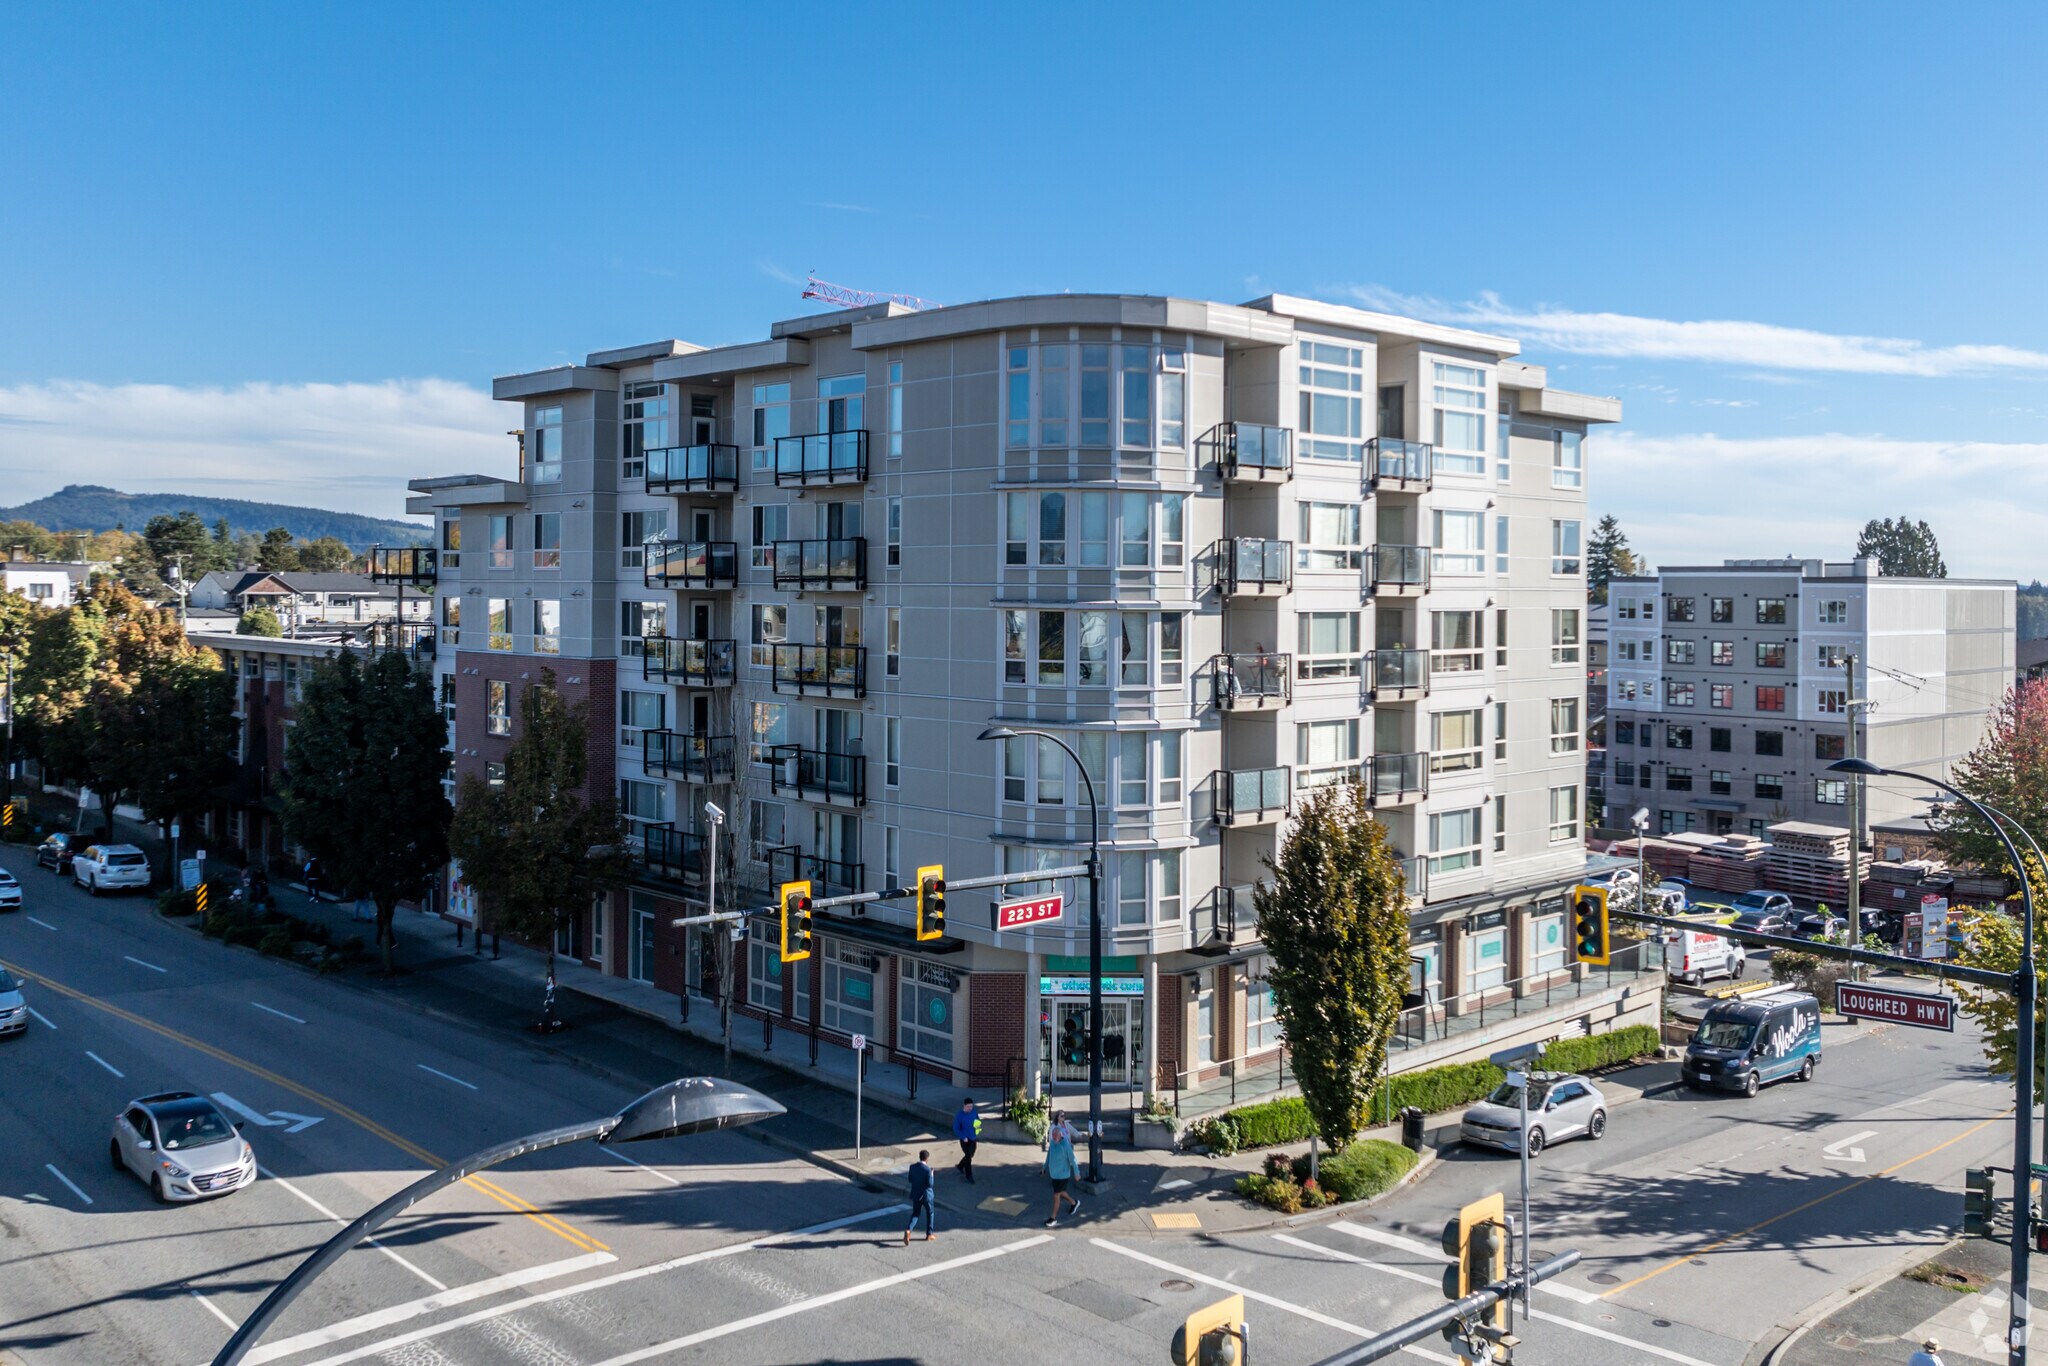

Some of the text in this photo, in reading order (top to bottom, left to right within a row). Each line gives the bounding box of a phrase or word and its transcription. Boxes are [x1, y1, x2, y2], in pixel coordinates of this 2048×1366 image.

[1008, 903, 1053, 922] 223 ST
[1842, 994, 1945, 1021] LOUGHEED HWY
[1772, 1006, 1806, 1058] Woola
